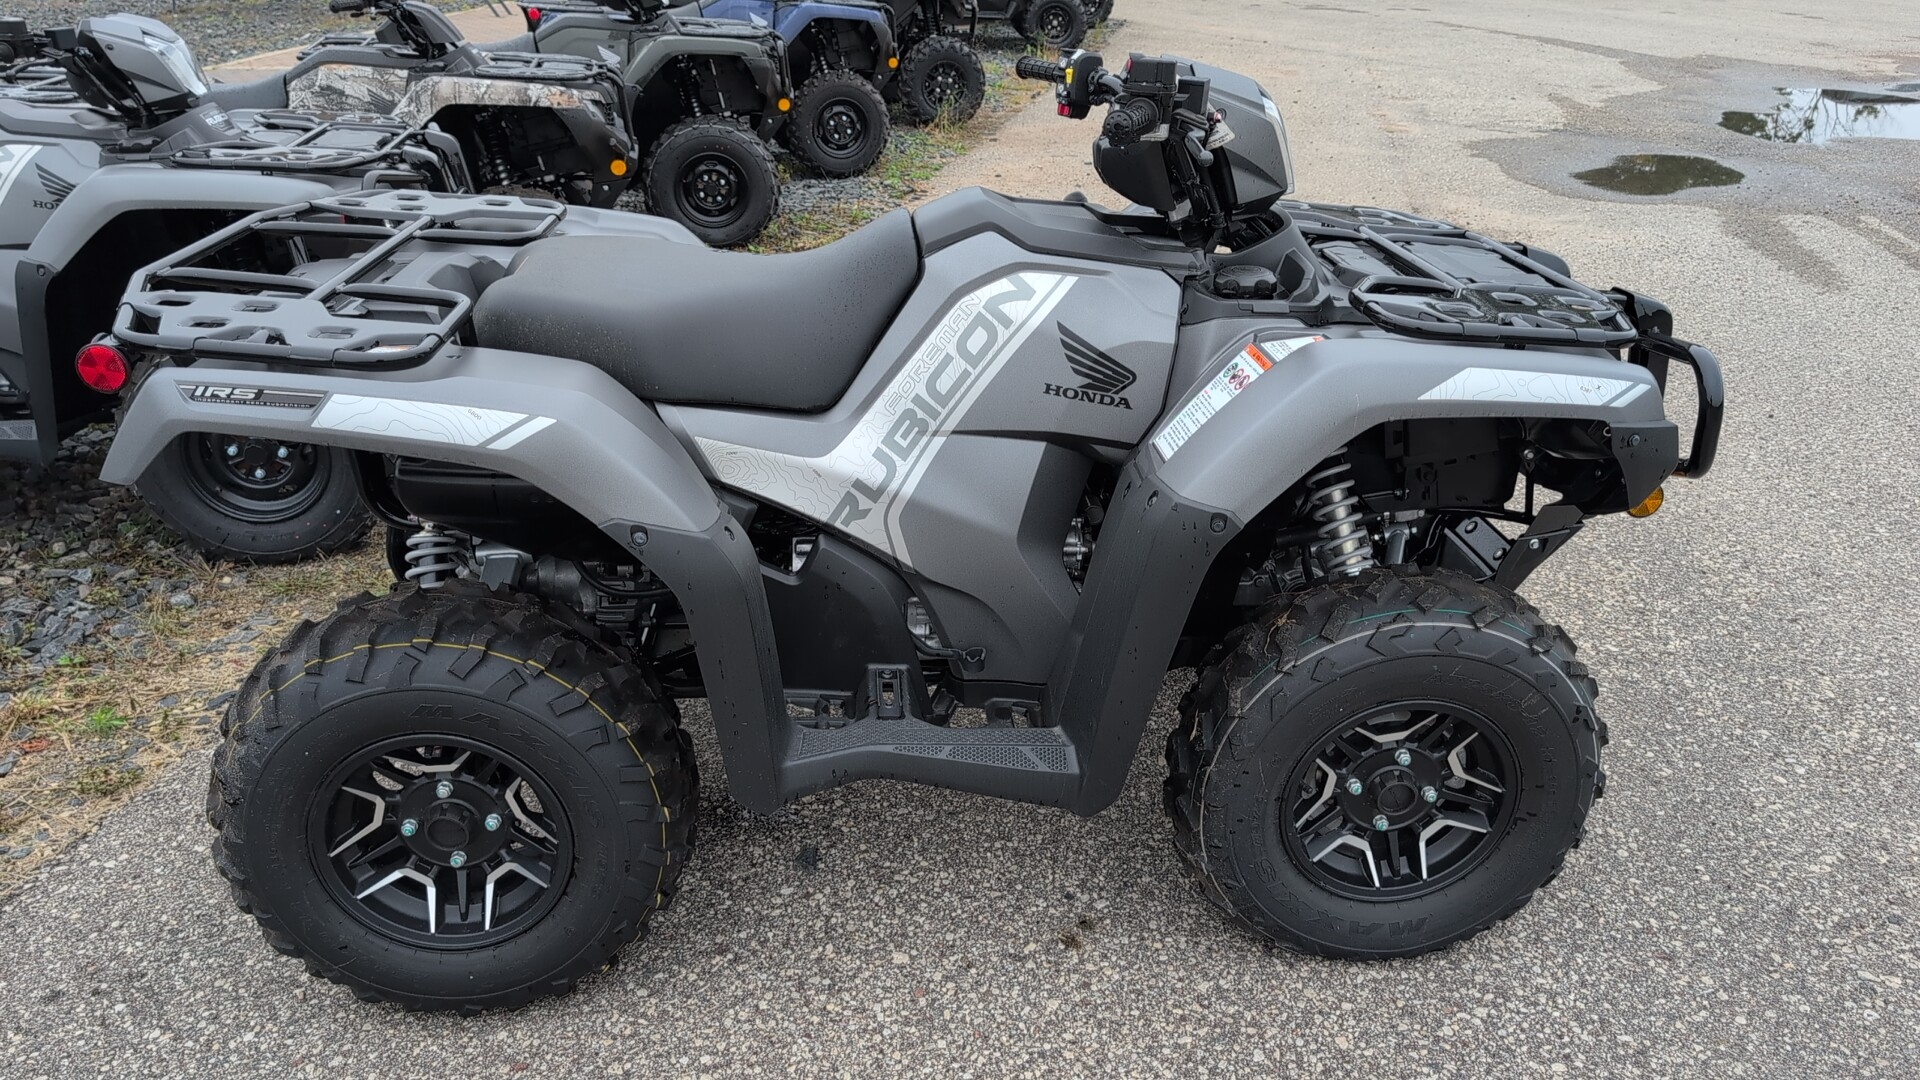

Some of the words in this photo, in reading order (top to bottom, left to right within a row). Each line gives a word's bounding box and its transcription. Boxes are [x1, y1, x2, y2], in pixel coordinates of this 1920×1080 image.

[884, 292, 981, 416] FOREMAN
[194, 386, 258, 400] IRS
[825, 274, 1036, 528] RUBICON
[1043, 383, 1133, 410] HONDA
